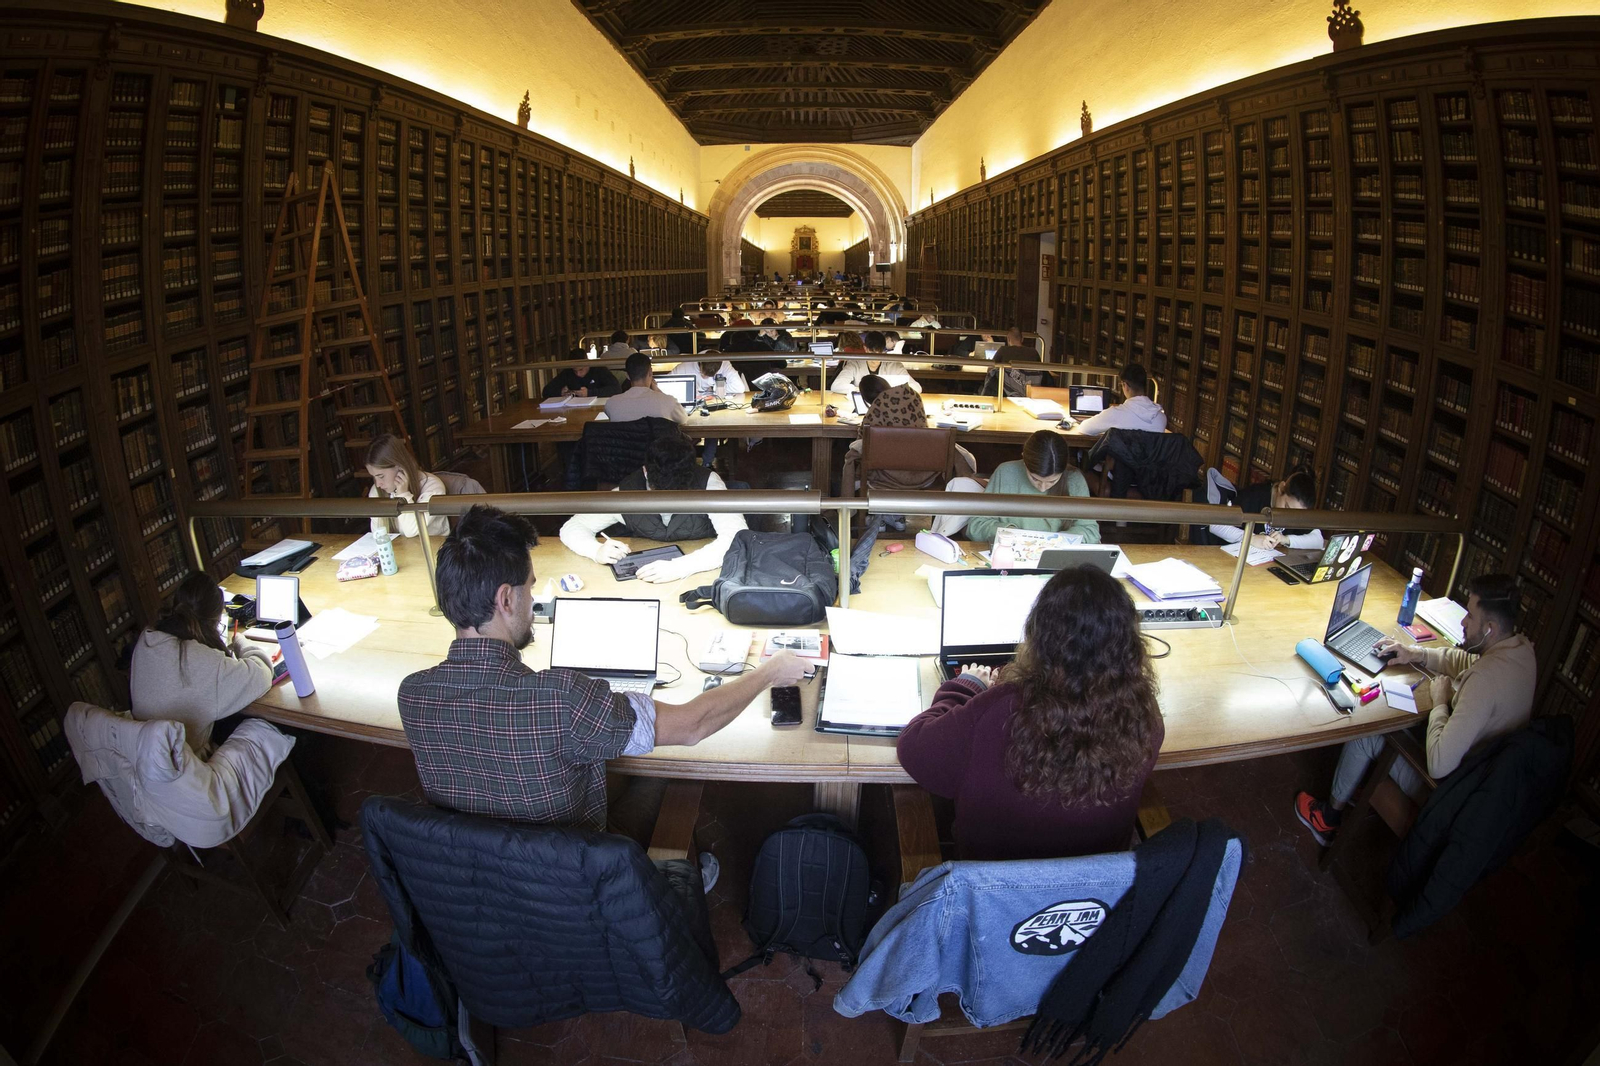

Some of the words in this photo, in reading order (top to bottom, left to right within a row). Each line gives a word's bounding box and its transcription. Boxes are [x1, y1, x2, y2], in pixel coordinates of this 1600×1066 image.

[764, 400, 781, 408] SMK
[1029, 912, 1071, 927] PEARL
[1074, 910, 1100, 922] JAM
